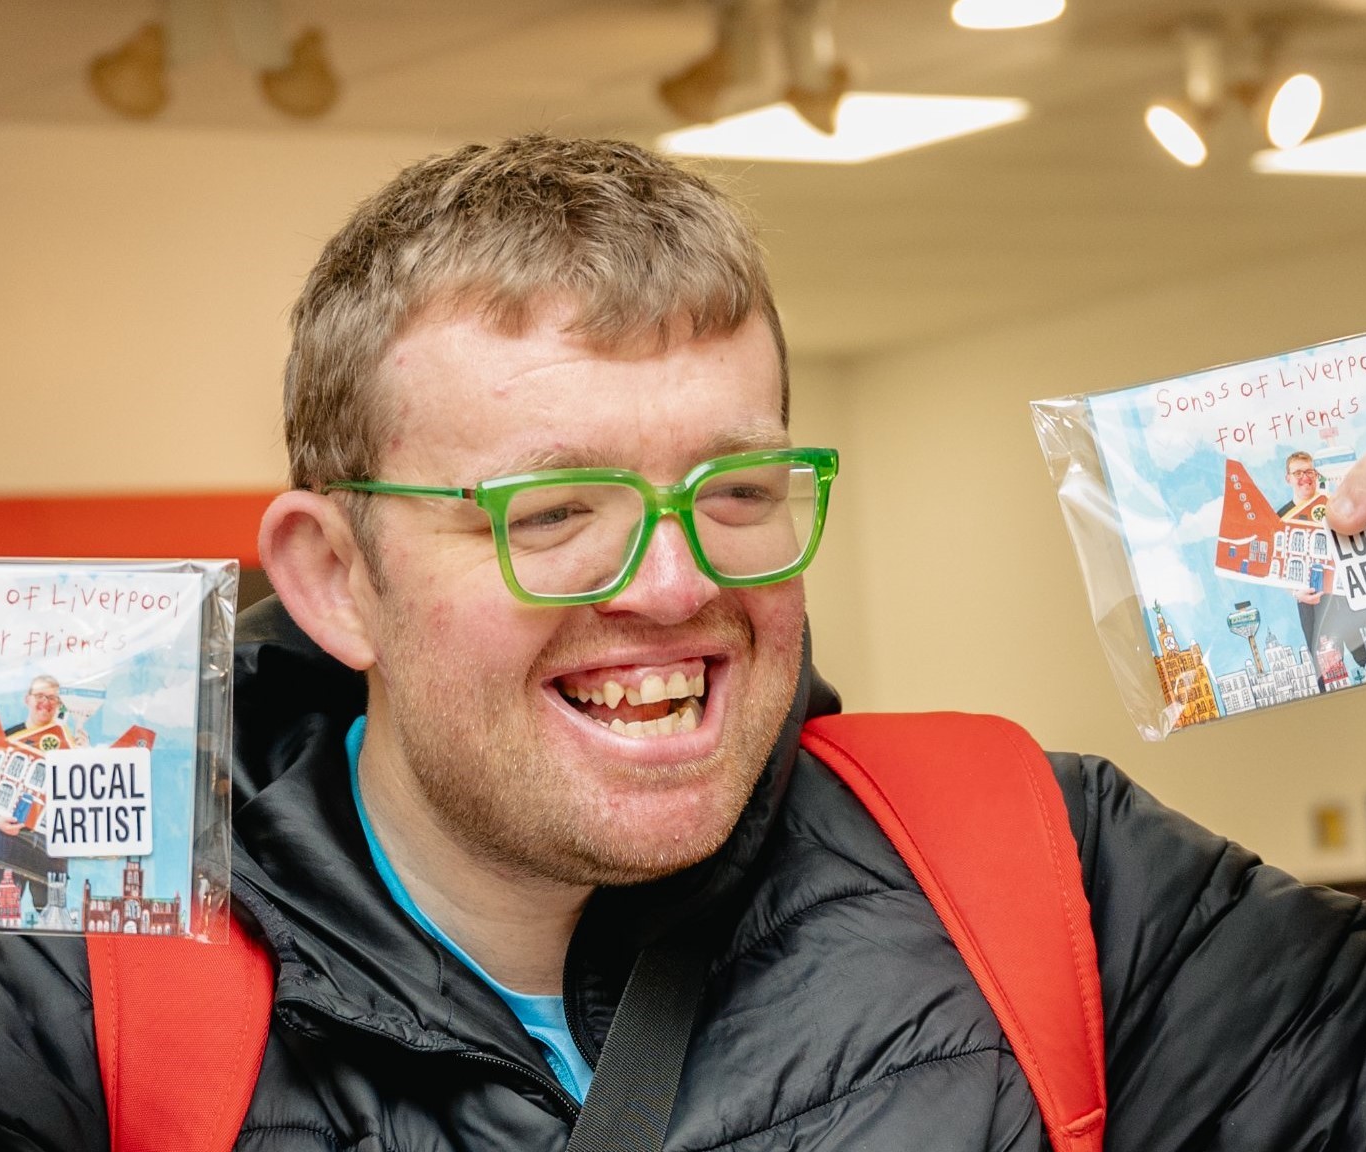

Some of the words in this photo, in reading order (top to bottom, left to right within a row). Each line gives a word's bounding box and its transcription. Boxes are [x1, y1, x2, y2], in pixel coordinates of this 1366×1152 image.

[1156, 384, 1229, 418] Songs
[1240, 374, 1269, 399] of
[6, 585, 41, 611] of
[52, 583, 180, 618] Liverpool
[52, 763, 145, 800] LOCAL
[51, 806, 146, 843] ARTIST
